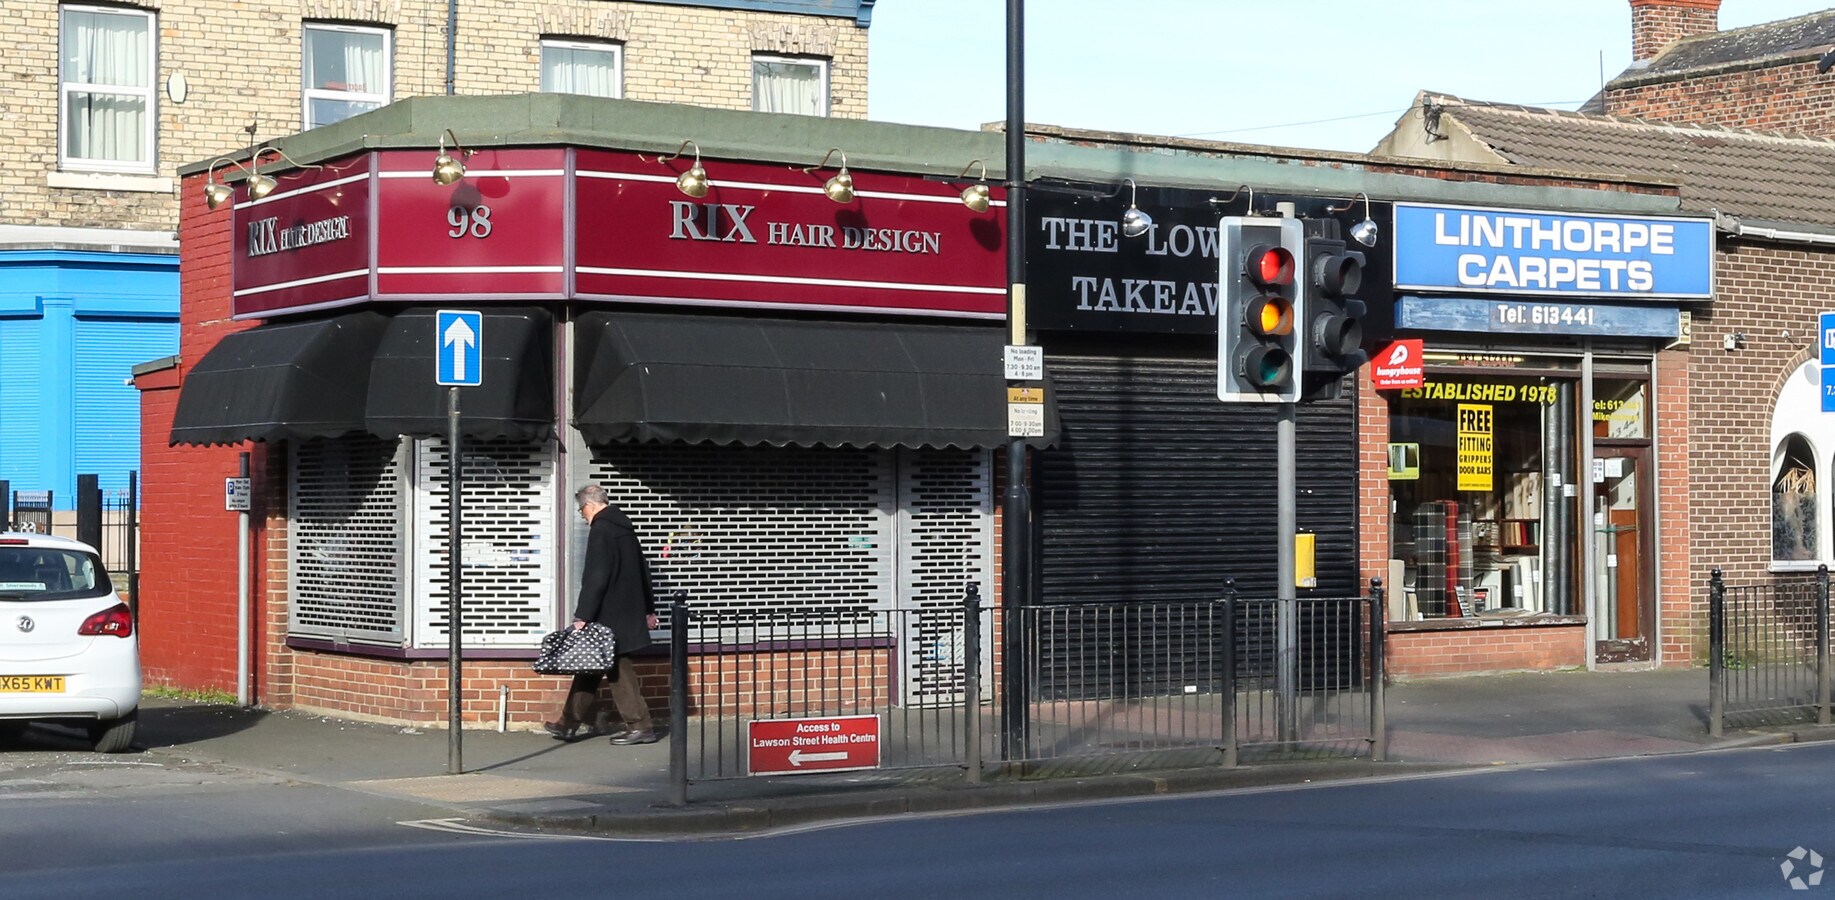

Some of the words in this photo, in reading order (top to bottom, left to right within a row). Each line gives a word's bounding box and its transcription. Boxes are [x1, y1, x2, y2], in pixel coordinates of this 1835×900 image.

[447, 205, 492, 238] 98
[669, 200, 757, 243] RIX
[767, 222, 836, 247] HAIR
[842, 226, 941, 254] DESIGN
[248, 216, 278, 256] RIX
[279, 226, 307, 250] HAIR
[307, 215, 349, 245] DESIGN
[1042, 217, 1118, 252] THE
[1146, 224, 1219, 258] LOW
[1435, 213, 1674, 255] LINTHORPE
[1457, 254, 1653, 291] CARPETS
[1072, 276, 1219, 315] TAKEAW
[1498, 305, 1527, 323] Tel:
[1532, 307, 1593, 325] 613441
[1376, 366, 1421, 377] hungryhouse
[1401, 383, 1516, 401] ESTABLISHED
[1519, 385, 1557, 403] 1978
[1460, 409, 1491, 432] FREE
[1459, 437, 1491, 452] FITTING
[1459, 454, 1491, 464] GRIPPERS
[1459, 466, 1475, 475] DOOR
[1477, 466, 1491, 475] BARS
[0, 677, 31, 690] X65
[34, 677, 62, 690] KWT
[796, 723, 829, 733] Access
[831, 722, 840, 731] to
[753, 737, 790, 748] Lawson
[793, 735, 820, 746] Street
[821, 734, 848, 745] Health
[850, 732, 876, 743] Centre
